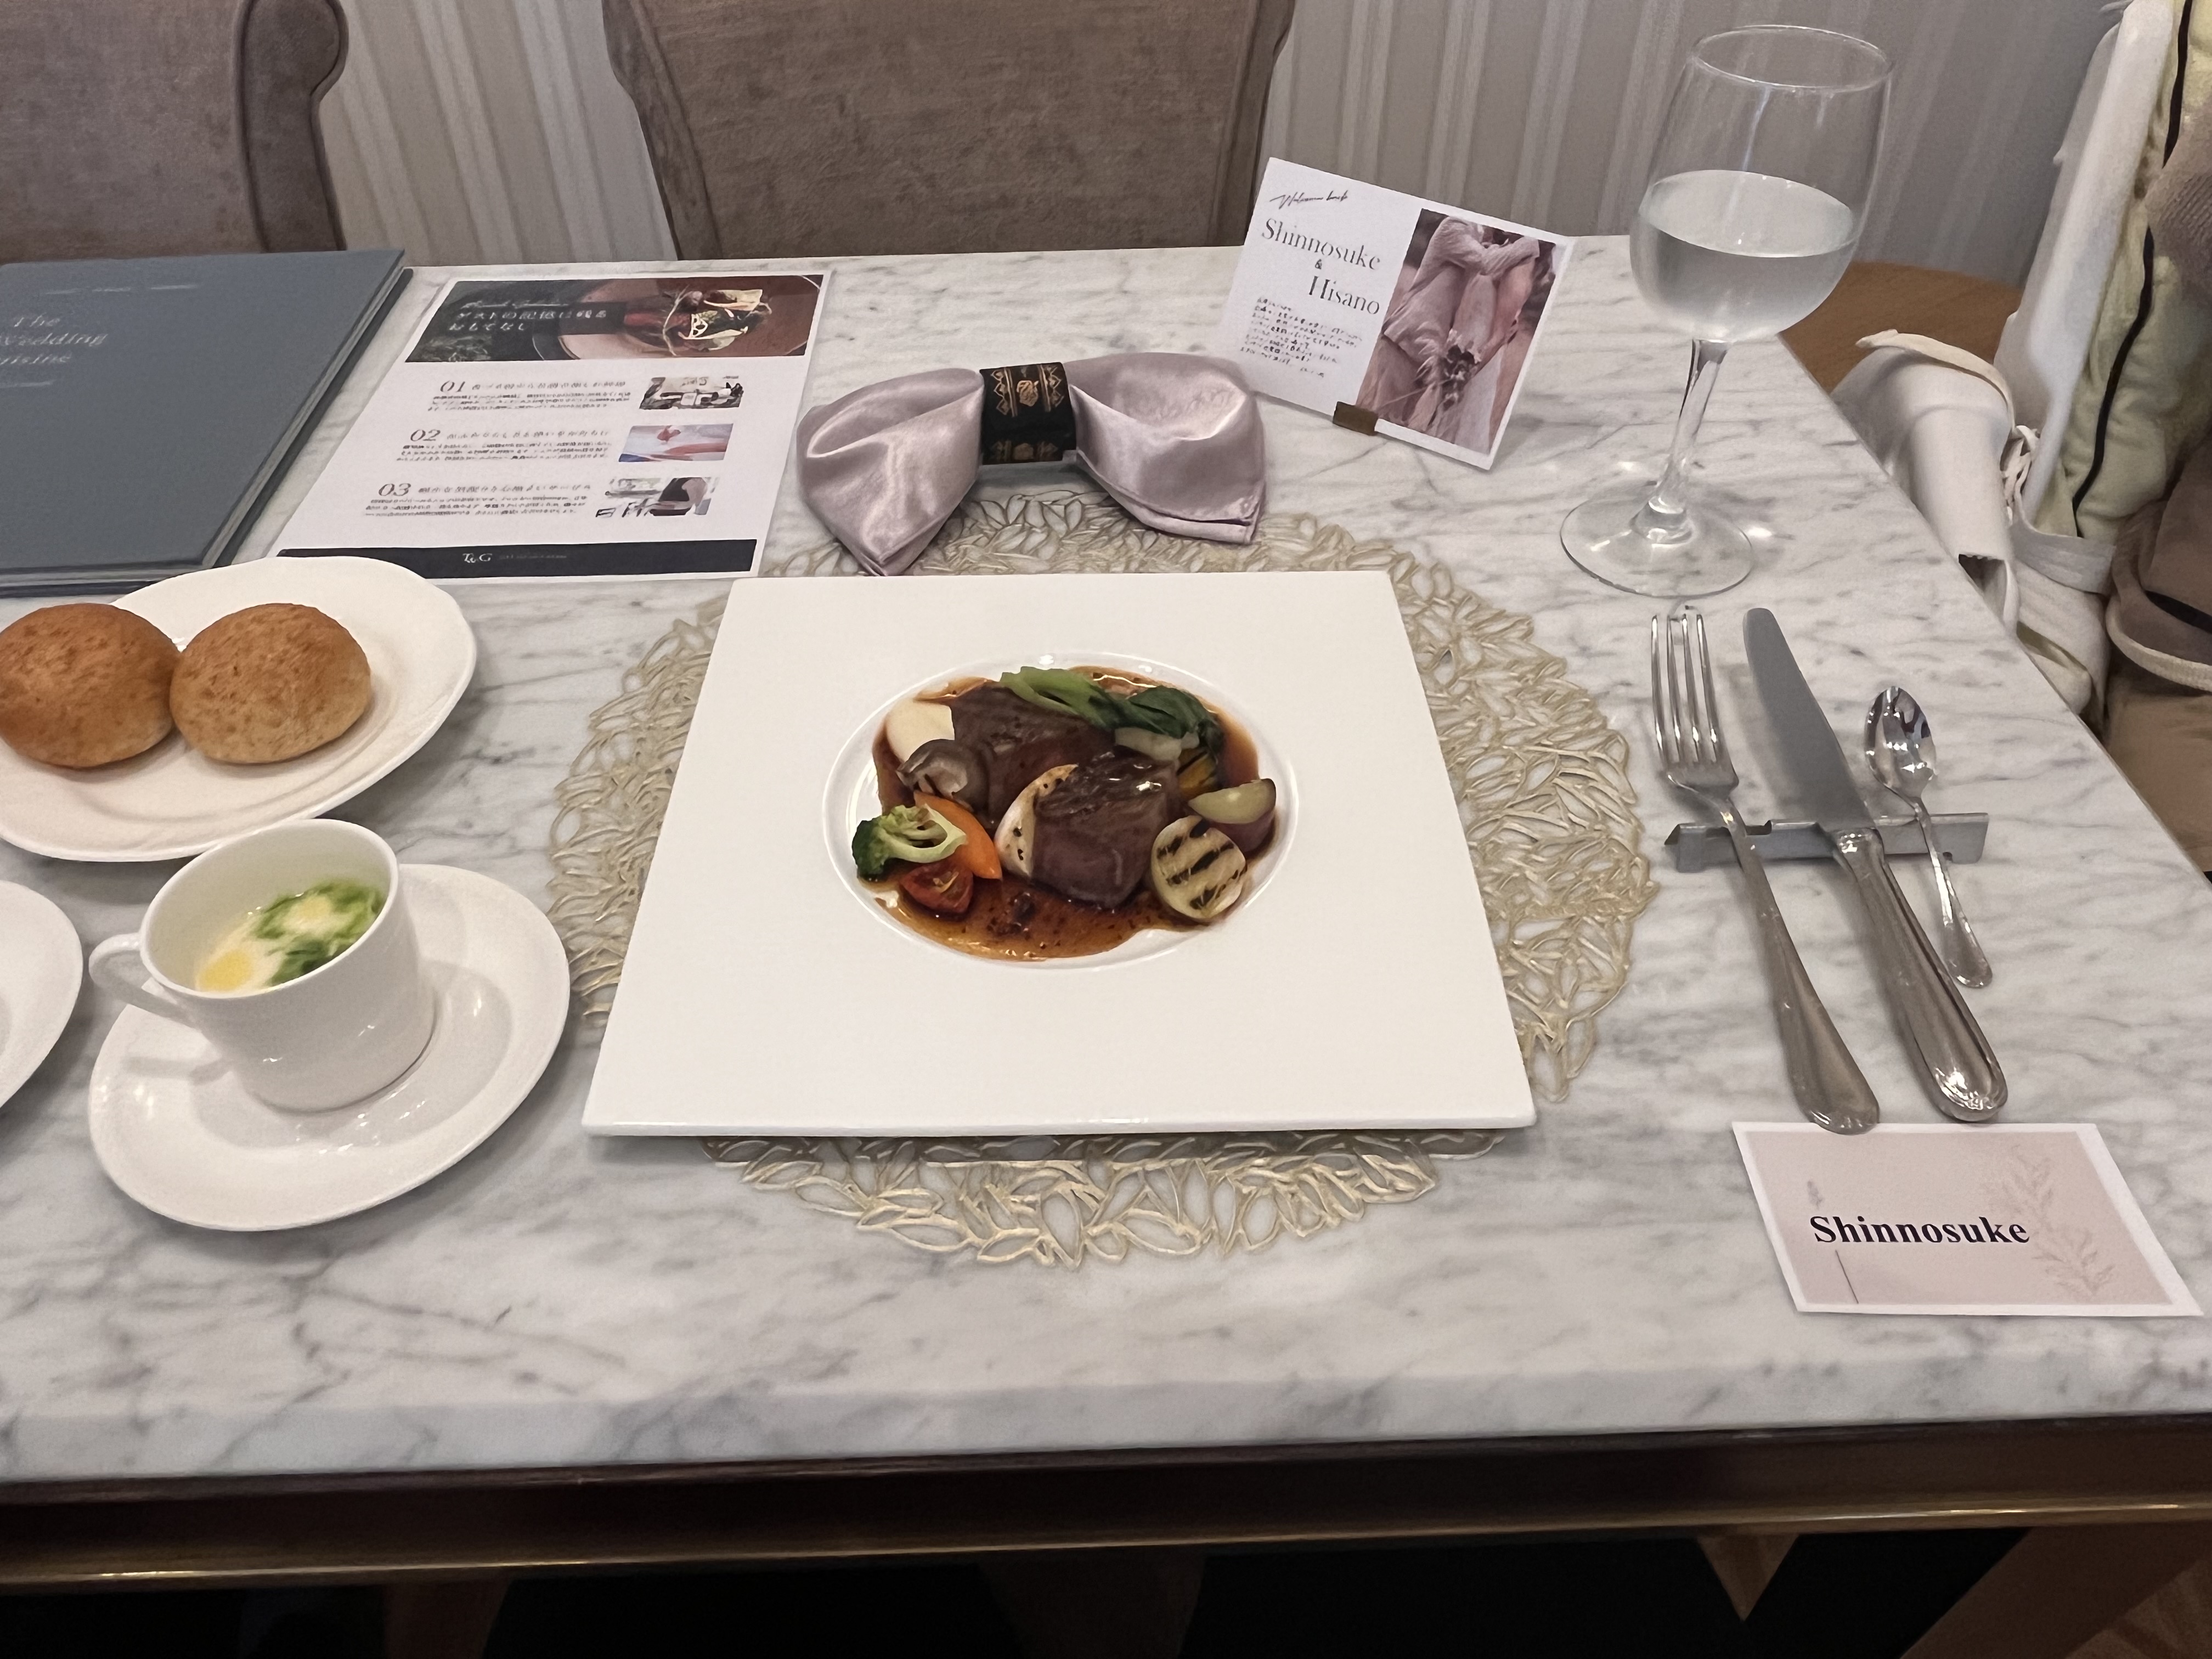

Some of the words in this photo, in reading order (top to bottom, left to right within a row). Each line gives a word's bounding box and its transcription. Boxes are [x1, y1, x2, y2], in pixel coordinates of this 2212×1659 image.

[1261, 218, 1380, 270] Shinnosuke
[1314, 258, 1322, 270] &
[1309, 275, 1380, 314] Hisano
[440, 380, 466, 392] 01
[410, 429, 441, 442] 02
[378, 483, 411, 496] 03
[1809, 1215, 2030, 1244] Shinnosuke
